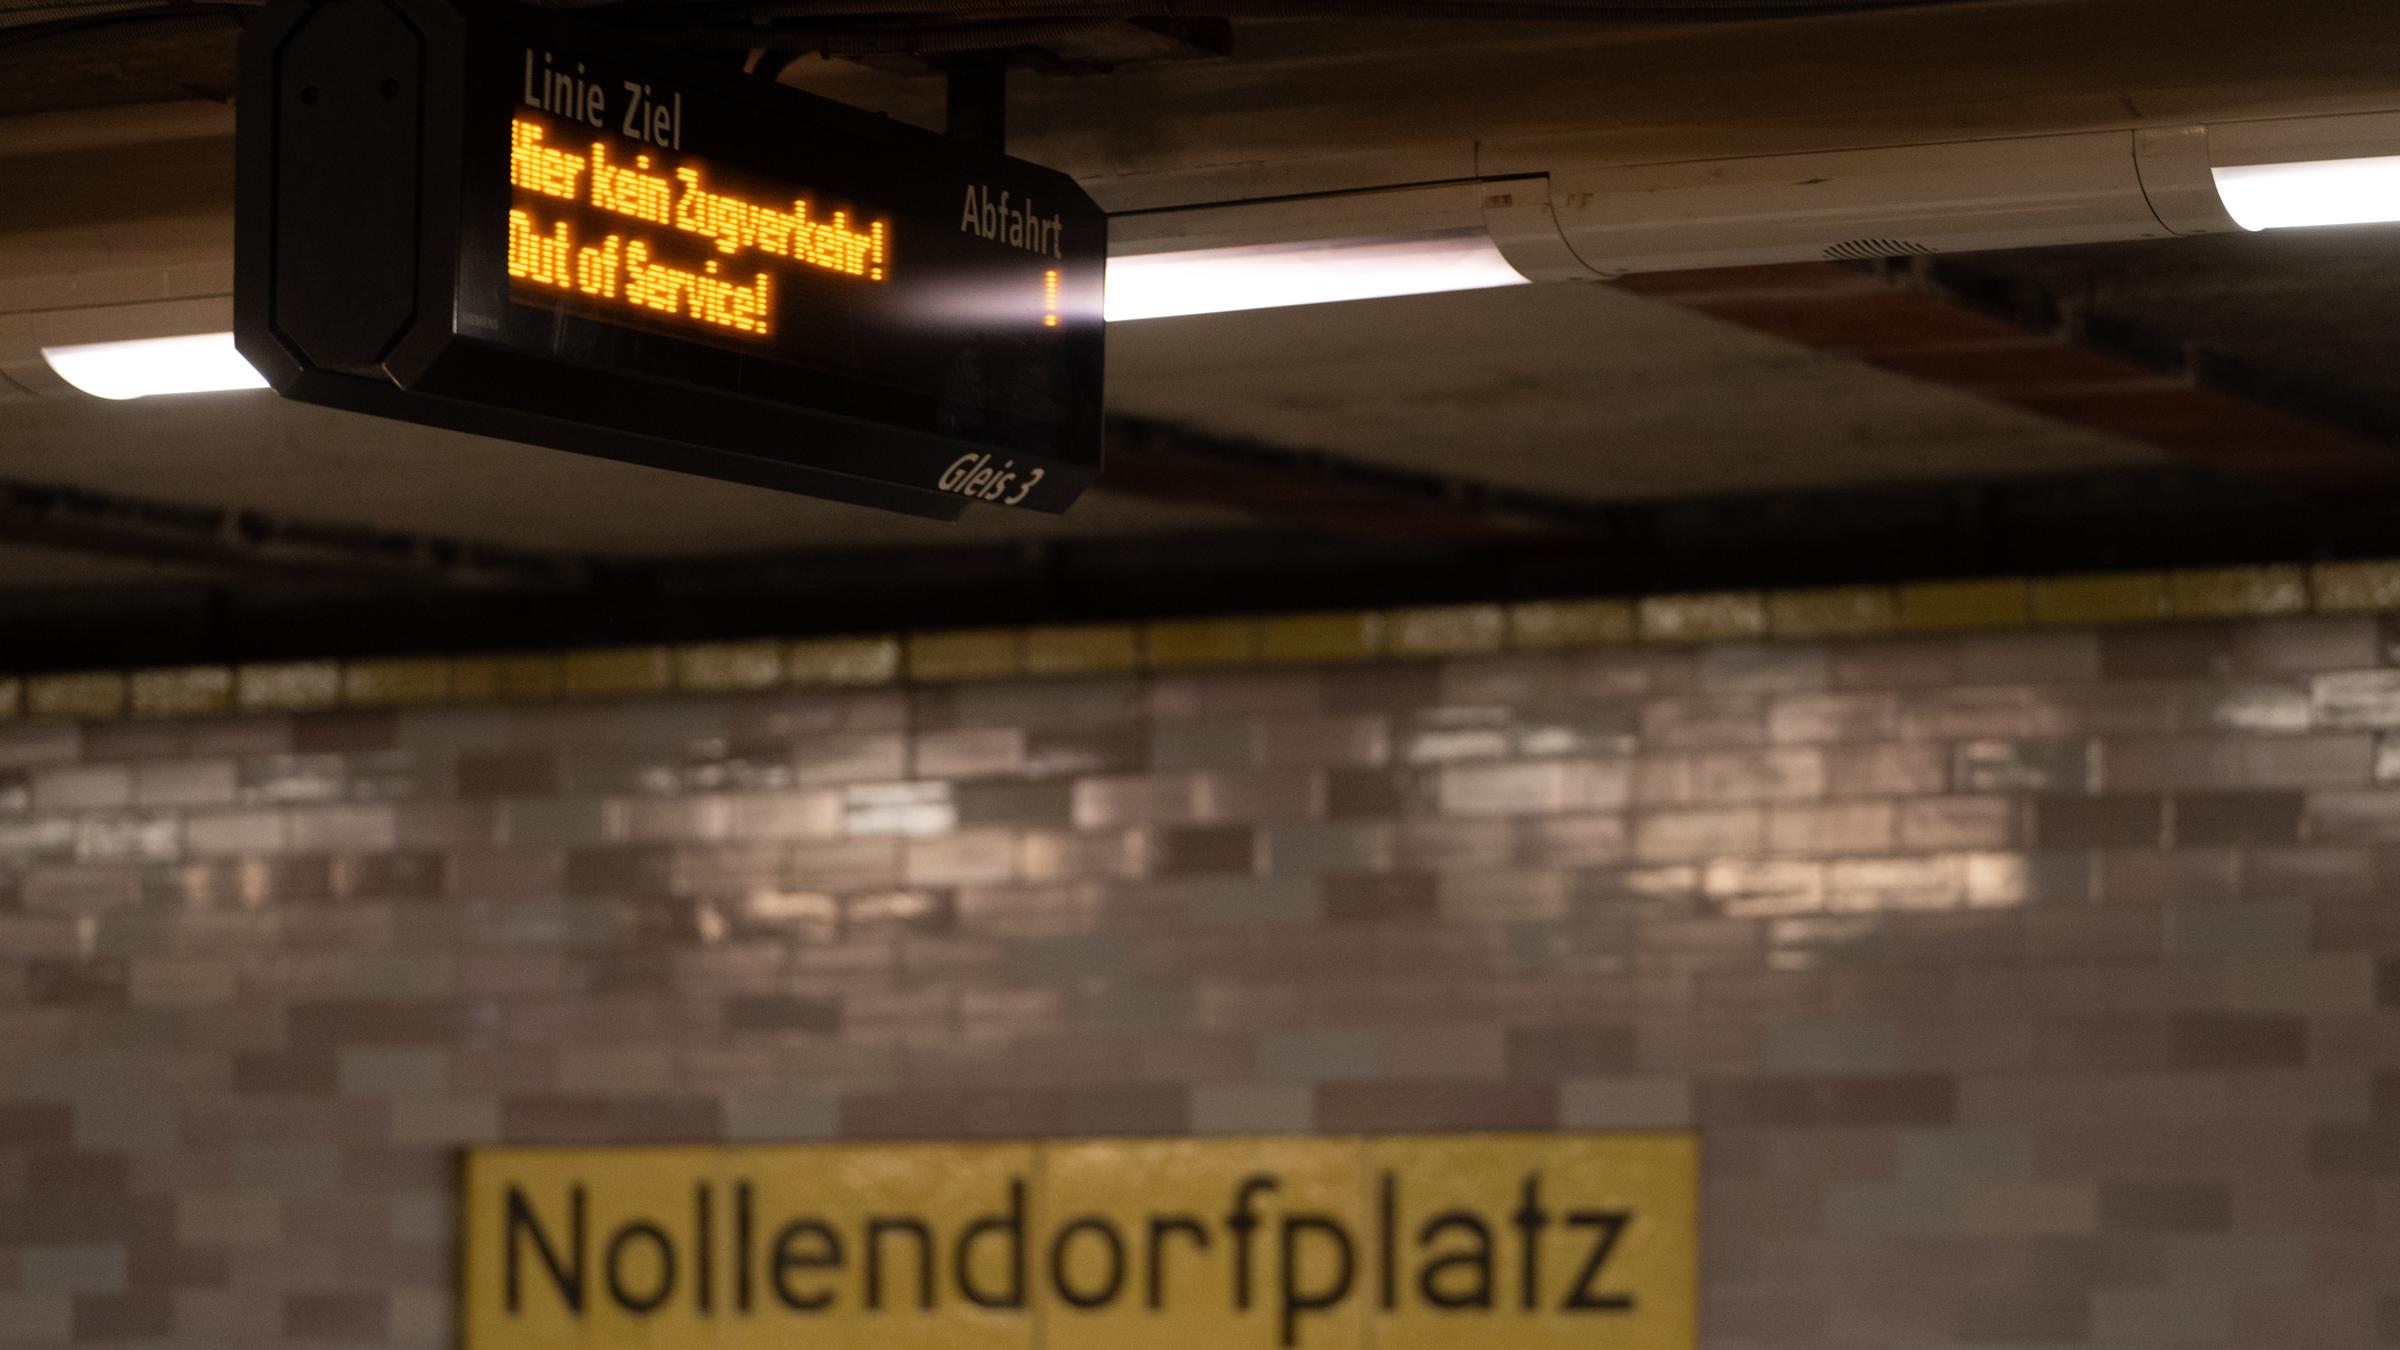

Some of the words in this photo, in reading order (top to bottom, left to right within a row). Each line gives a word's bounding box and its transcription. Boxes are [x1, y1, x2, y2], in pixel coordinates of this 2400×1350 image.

[524, 47, 605, 128] Linie
[622, 80, 681, 151] Ziel
[510, 118, 585, 200] Hier
[591, 141, 671, 226] kein
[675, 166, 884, 281] Zugverkehr!
[960, 184, 1063, 260] Abfahrt
[507, 208, 572, 288] Out
[577, 234, 619, 299] of
[626, 240, 769, 335] Service!
[937, 452, 1017, 502] Gleis
[1004, 467, 1045, 506] 3
[500, 1170, 1637, 1348] Nollendorfplatz
